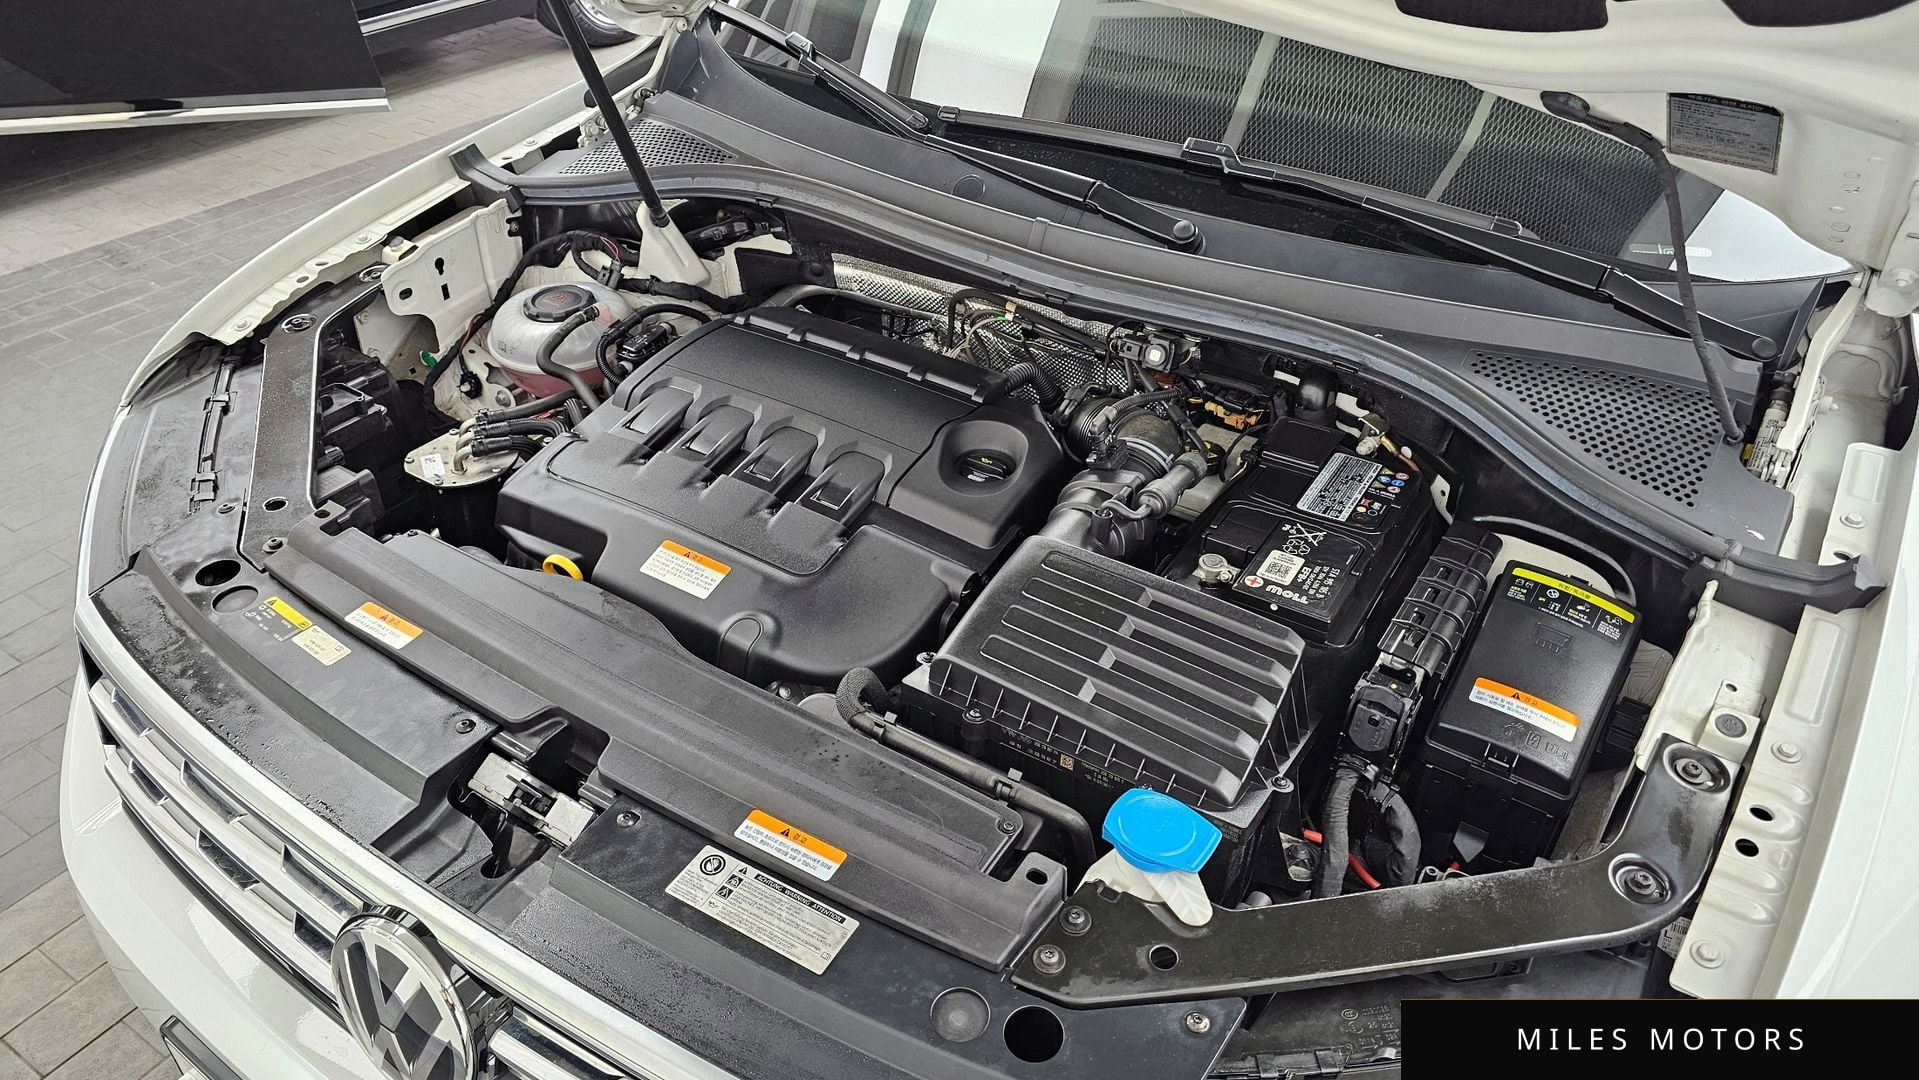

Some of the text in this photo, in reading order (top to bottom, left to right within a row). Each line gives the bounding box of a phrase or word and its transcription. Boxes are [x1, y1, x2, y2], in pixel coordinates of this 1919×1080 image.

[756, 875, 842, 922] ACHTUNG WARNING ATTENTION
